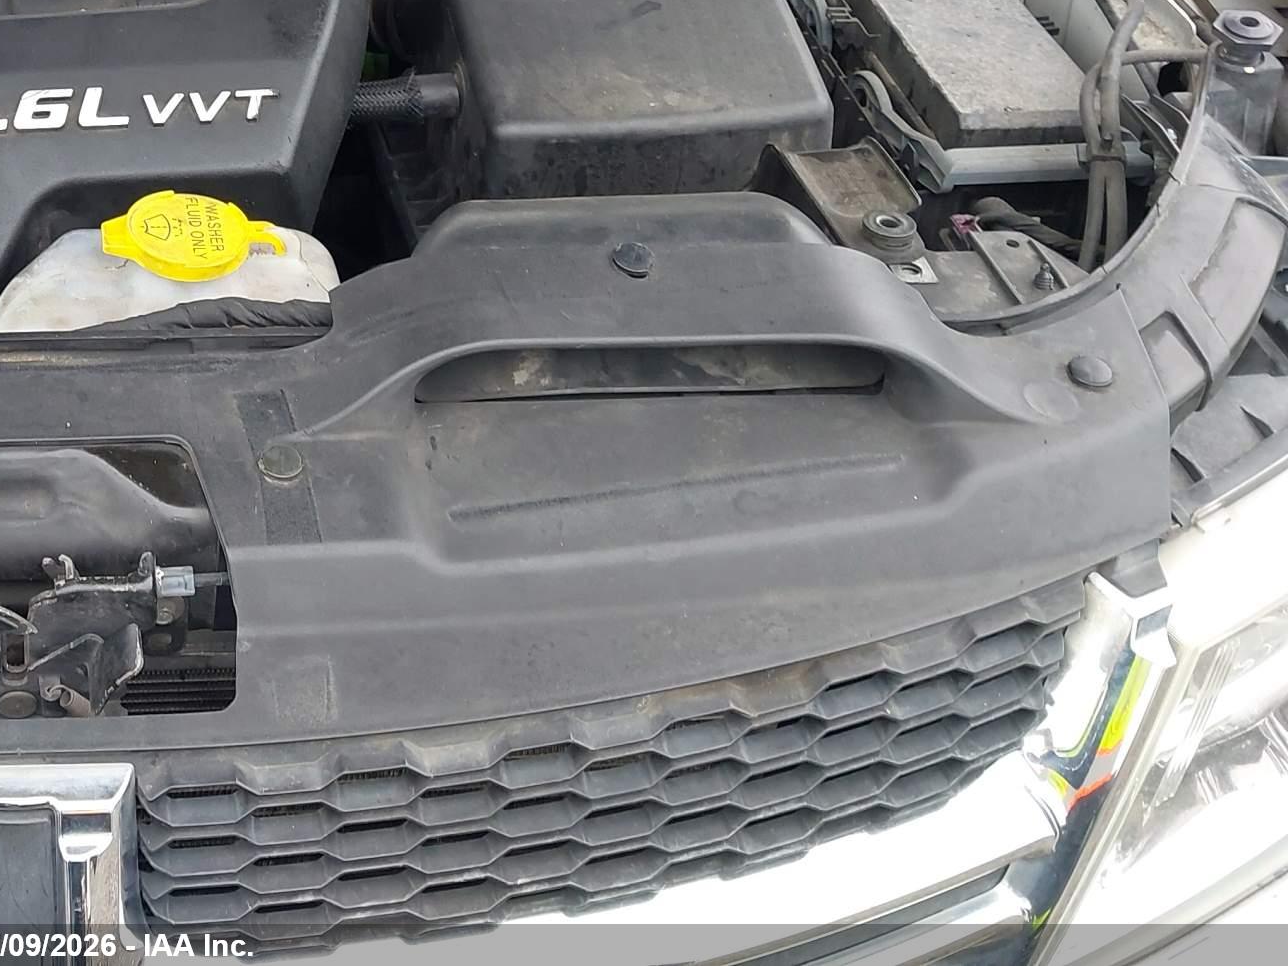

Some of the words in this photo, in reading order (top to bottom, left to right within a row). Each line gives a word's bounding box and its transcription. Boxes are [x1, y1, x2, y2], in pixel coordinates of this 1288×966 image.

[143, 88, 281, 127] VVT
[185, 197, 202, 227] FLUID
[205, 202, 225, 252] WASHER
[190, 230, 210, 260] ONLY
